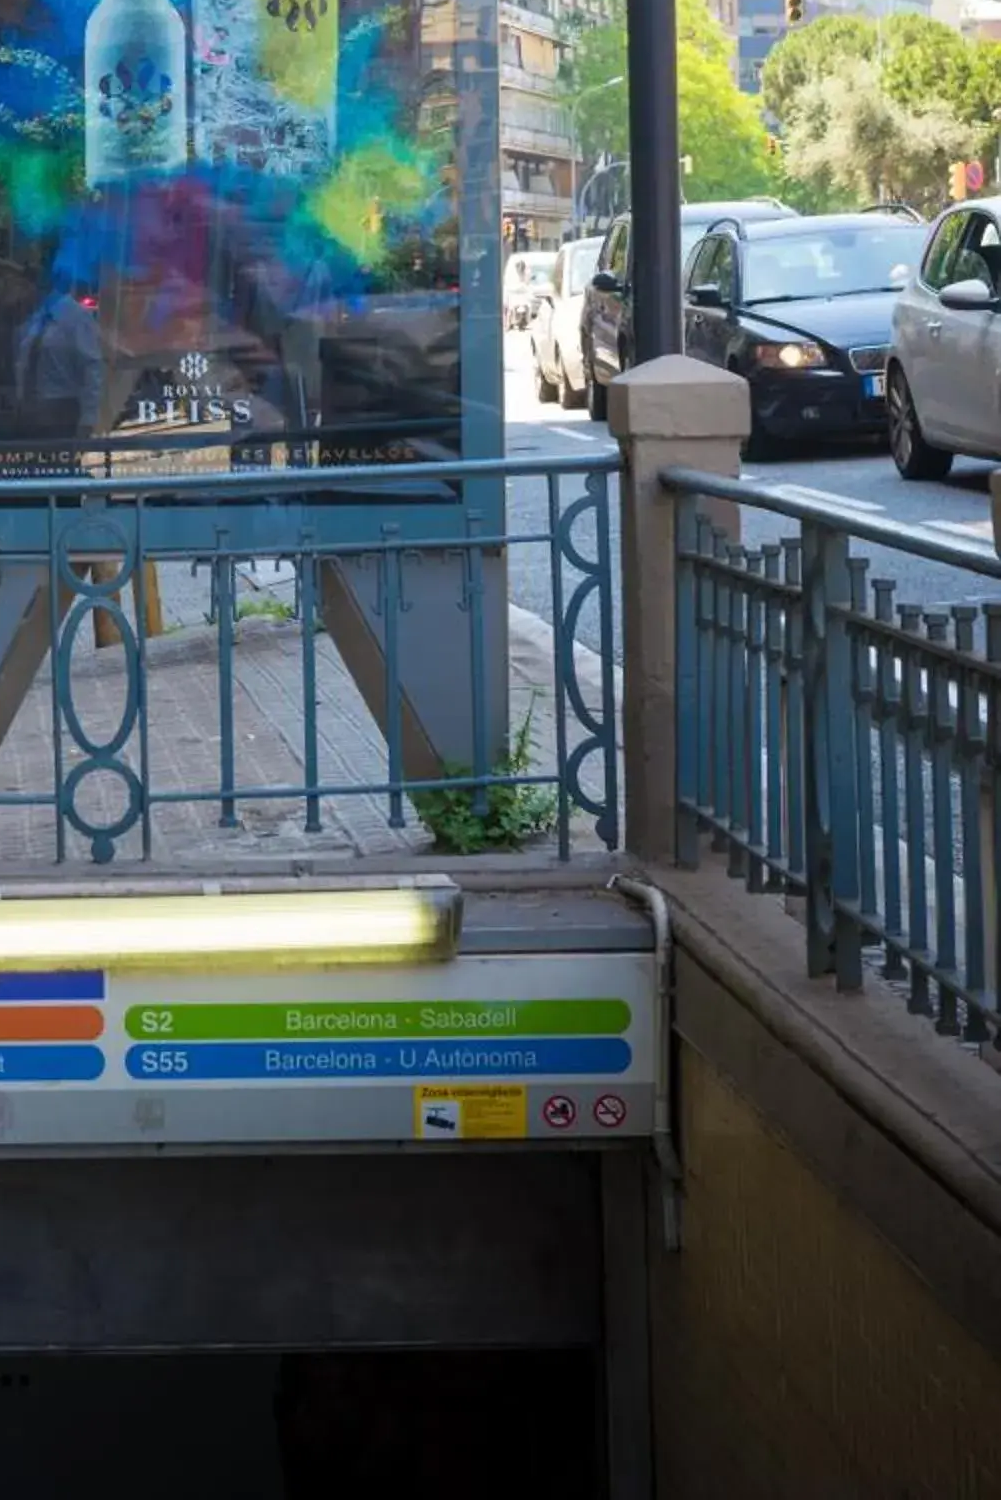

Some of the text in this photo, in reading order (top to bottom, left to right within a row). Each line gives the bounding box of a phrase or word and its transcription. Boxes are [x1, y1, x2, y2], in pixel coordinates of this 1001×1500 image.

[163, 384, 223, 397] ROYAL
[137, 398, 252, 423] BLISS
[141, 1010, 174, 1033] S2
[285, 1009, 398, 1031] Barcelona
[420, 1007, 517, 1029] Sabadell
[142, 1050, 189, 1073] S55
[265, 1049, 377, 1071] Barcelona
